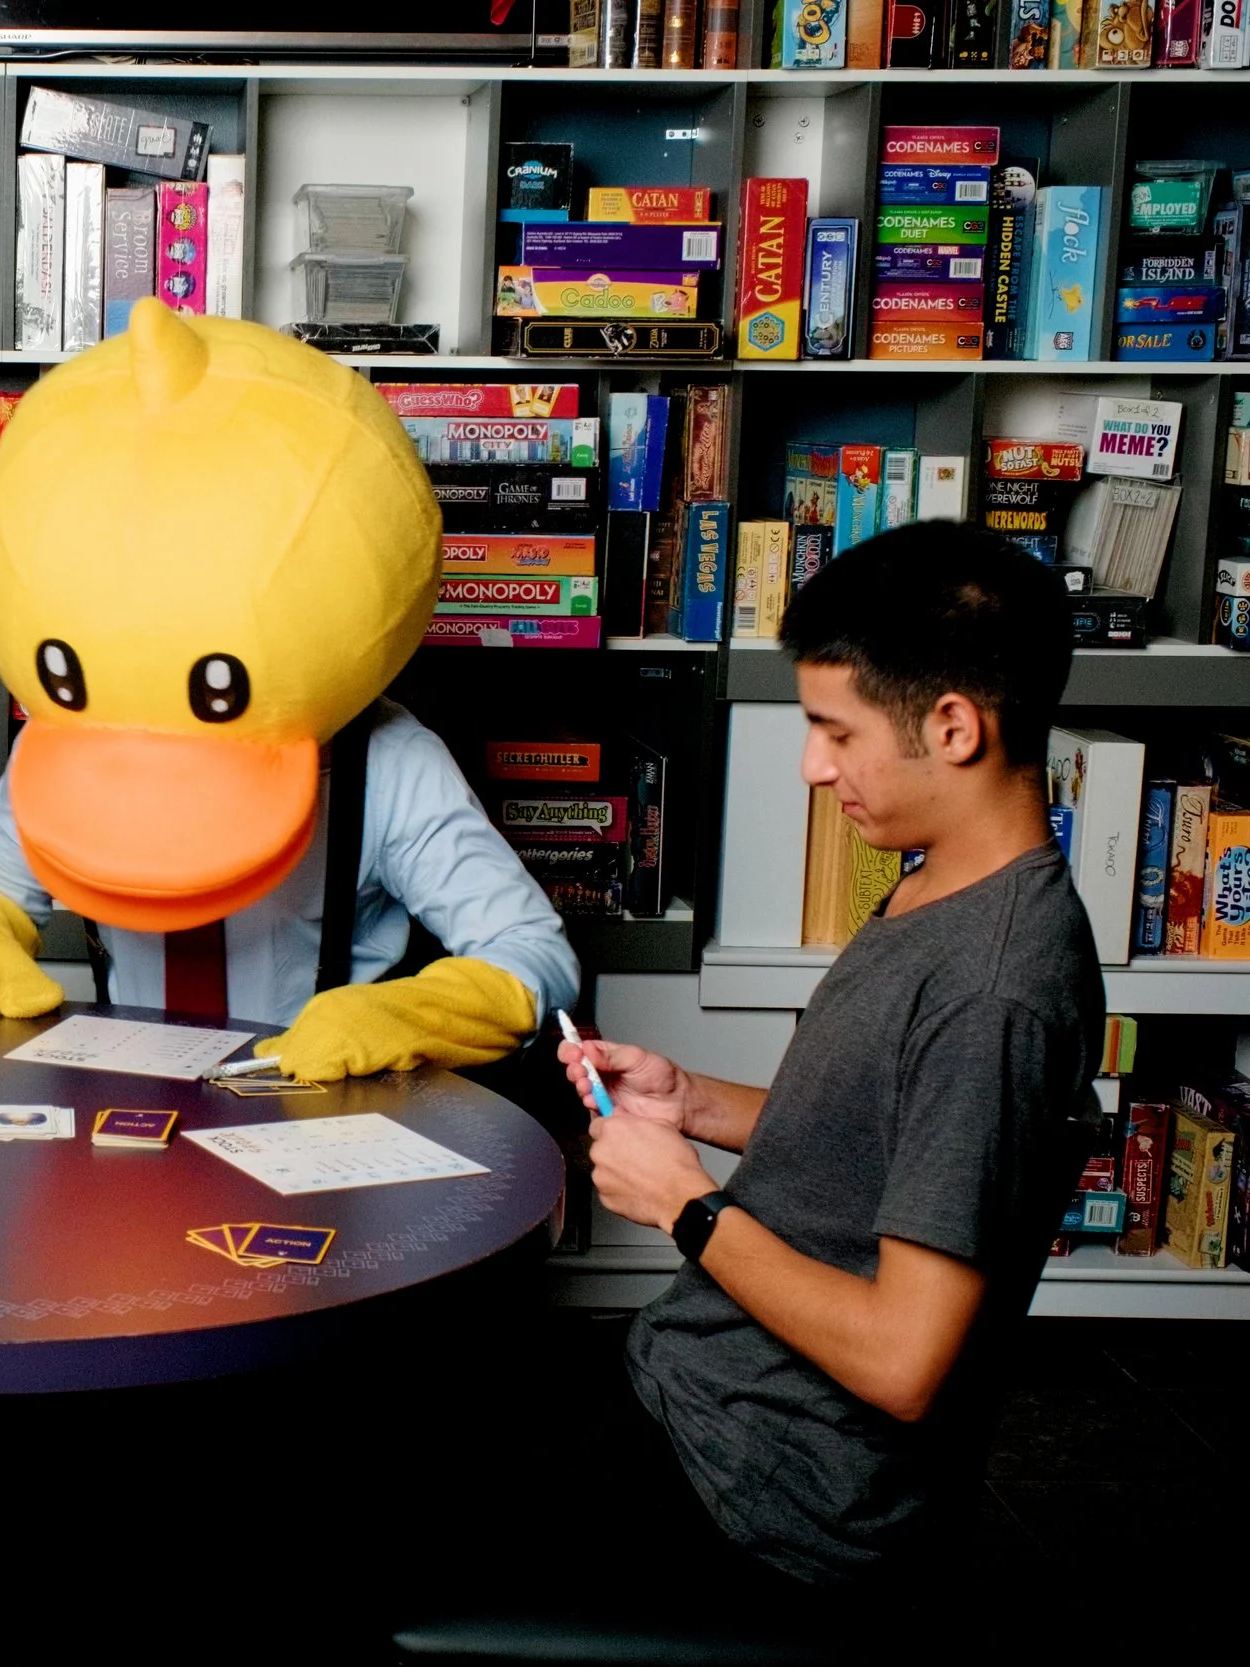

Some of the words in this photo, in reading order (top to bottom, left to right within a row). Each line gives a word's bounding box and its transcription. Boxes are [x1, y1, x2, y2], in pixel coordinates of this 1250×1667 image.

[887, 141, 970, 153] CODENAMES
[884, 170, 924, 178] CODENAMES
[926, 168, 952, 179] Disney
[632, 192, 678, 207] CATAN
[1134, 203, 1196, 215] EMPLOYED
[876, 217, 956, 228] CODENAMES
[133, 209, 151, 274] Broom
[901, 229, 928, 239] DUET
[1014, 215, 1024, 257] ESCAPE
[112, 211, 129, 279] Service
[893, 247, 933, 255] CODENAMES
[938, 245, 959, 255] MARVEL
[999, 216, 1014, 271] HIDDEN
[755, 216, 784, 302] CATAN
[1142, 258, 1195, 267] FORBIDDEN
[1011, 262, 1022, 295] FROM
[1141, 268, 1195, 283] ISLAND
[560, 287, 636, 308] Cadoo
[816, 251, 833, 329] CENTURY
[872, 298, 954, 310] CODENAMES
[995, 274, 1010, 324] CASTLE
[1008, 299, 1016, 320] THE
[873, 333, 946, 344] CODENAMES
[1135, 333, 1172, 348] SALE
[889, 344, 929, 353] PICTURES
[448, 422, 548, 440] MONOPOLY
[1103, 420, 1133, 432] WHAT
[1133, 422, 1149, 434] DO
[1151, 423, 1171, 437] YOU
[481, 441, 513, 449] CITY
[1099, 433, 1169, 458] MEME?
[1003, 446, 1035, 460] NUT
[1001, 461, 1015, 471] SO
[1016, 458, 1038, 470] FAST
[433, 488, 487, 500] ONOPOLY
[499, 482, 528, 494] GAME
[1006, 482, 1039, 493] NIGHT
[496, 493, 540, 505] THRONES
[701, 511, 719, 539] LAS
[986, 511, 1047, 530] WEREWORDS
[443, 547, 485, 560] OPOLY
[792, 535, 807, 582] MUNCHKIN
[698, 544, 718, 593] VEGAS
[447, 583, 557, 601] MONOPOLY
[497, 752, 536, 763] SECRET
[540, 753, 580, 764] HITLER
[506, 802, 538, 822] Say
[537, 801, 608, 823] Anything
[1181, 793, 1204, 843] Tsuro
[1215, 846, 1232, 921] What's
[1230, 852, 1245, 921] yours
[115, 1119, 156, 1128] ACTION
[1136, 1161, 1148, 1203] SUSPECTS
[264, 1236, 312, 1248] ACTION
